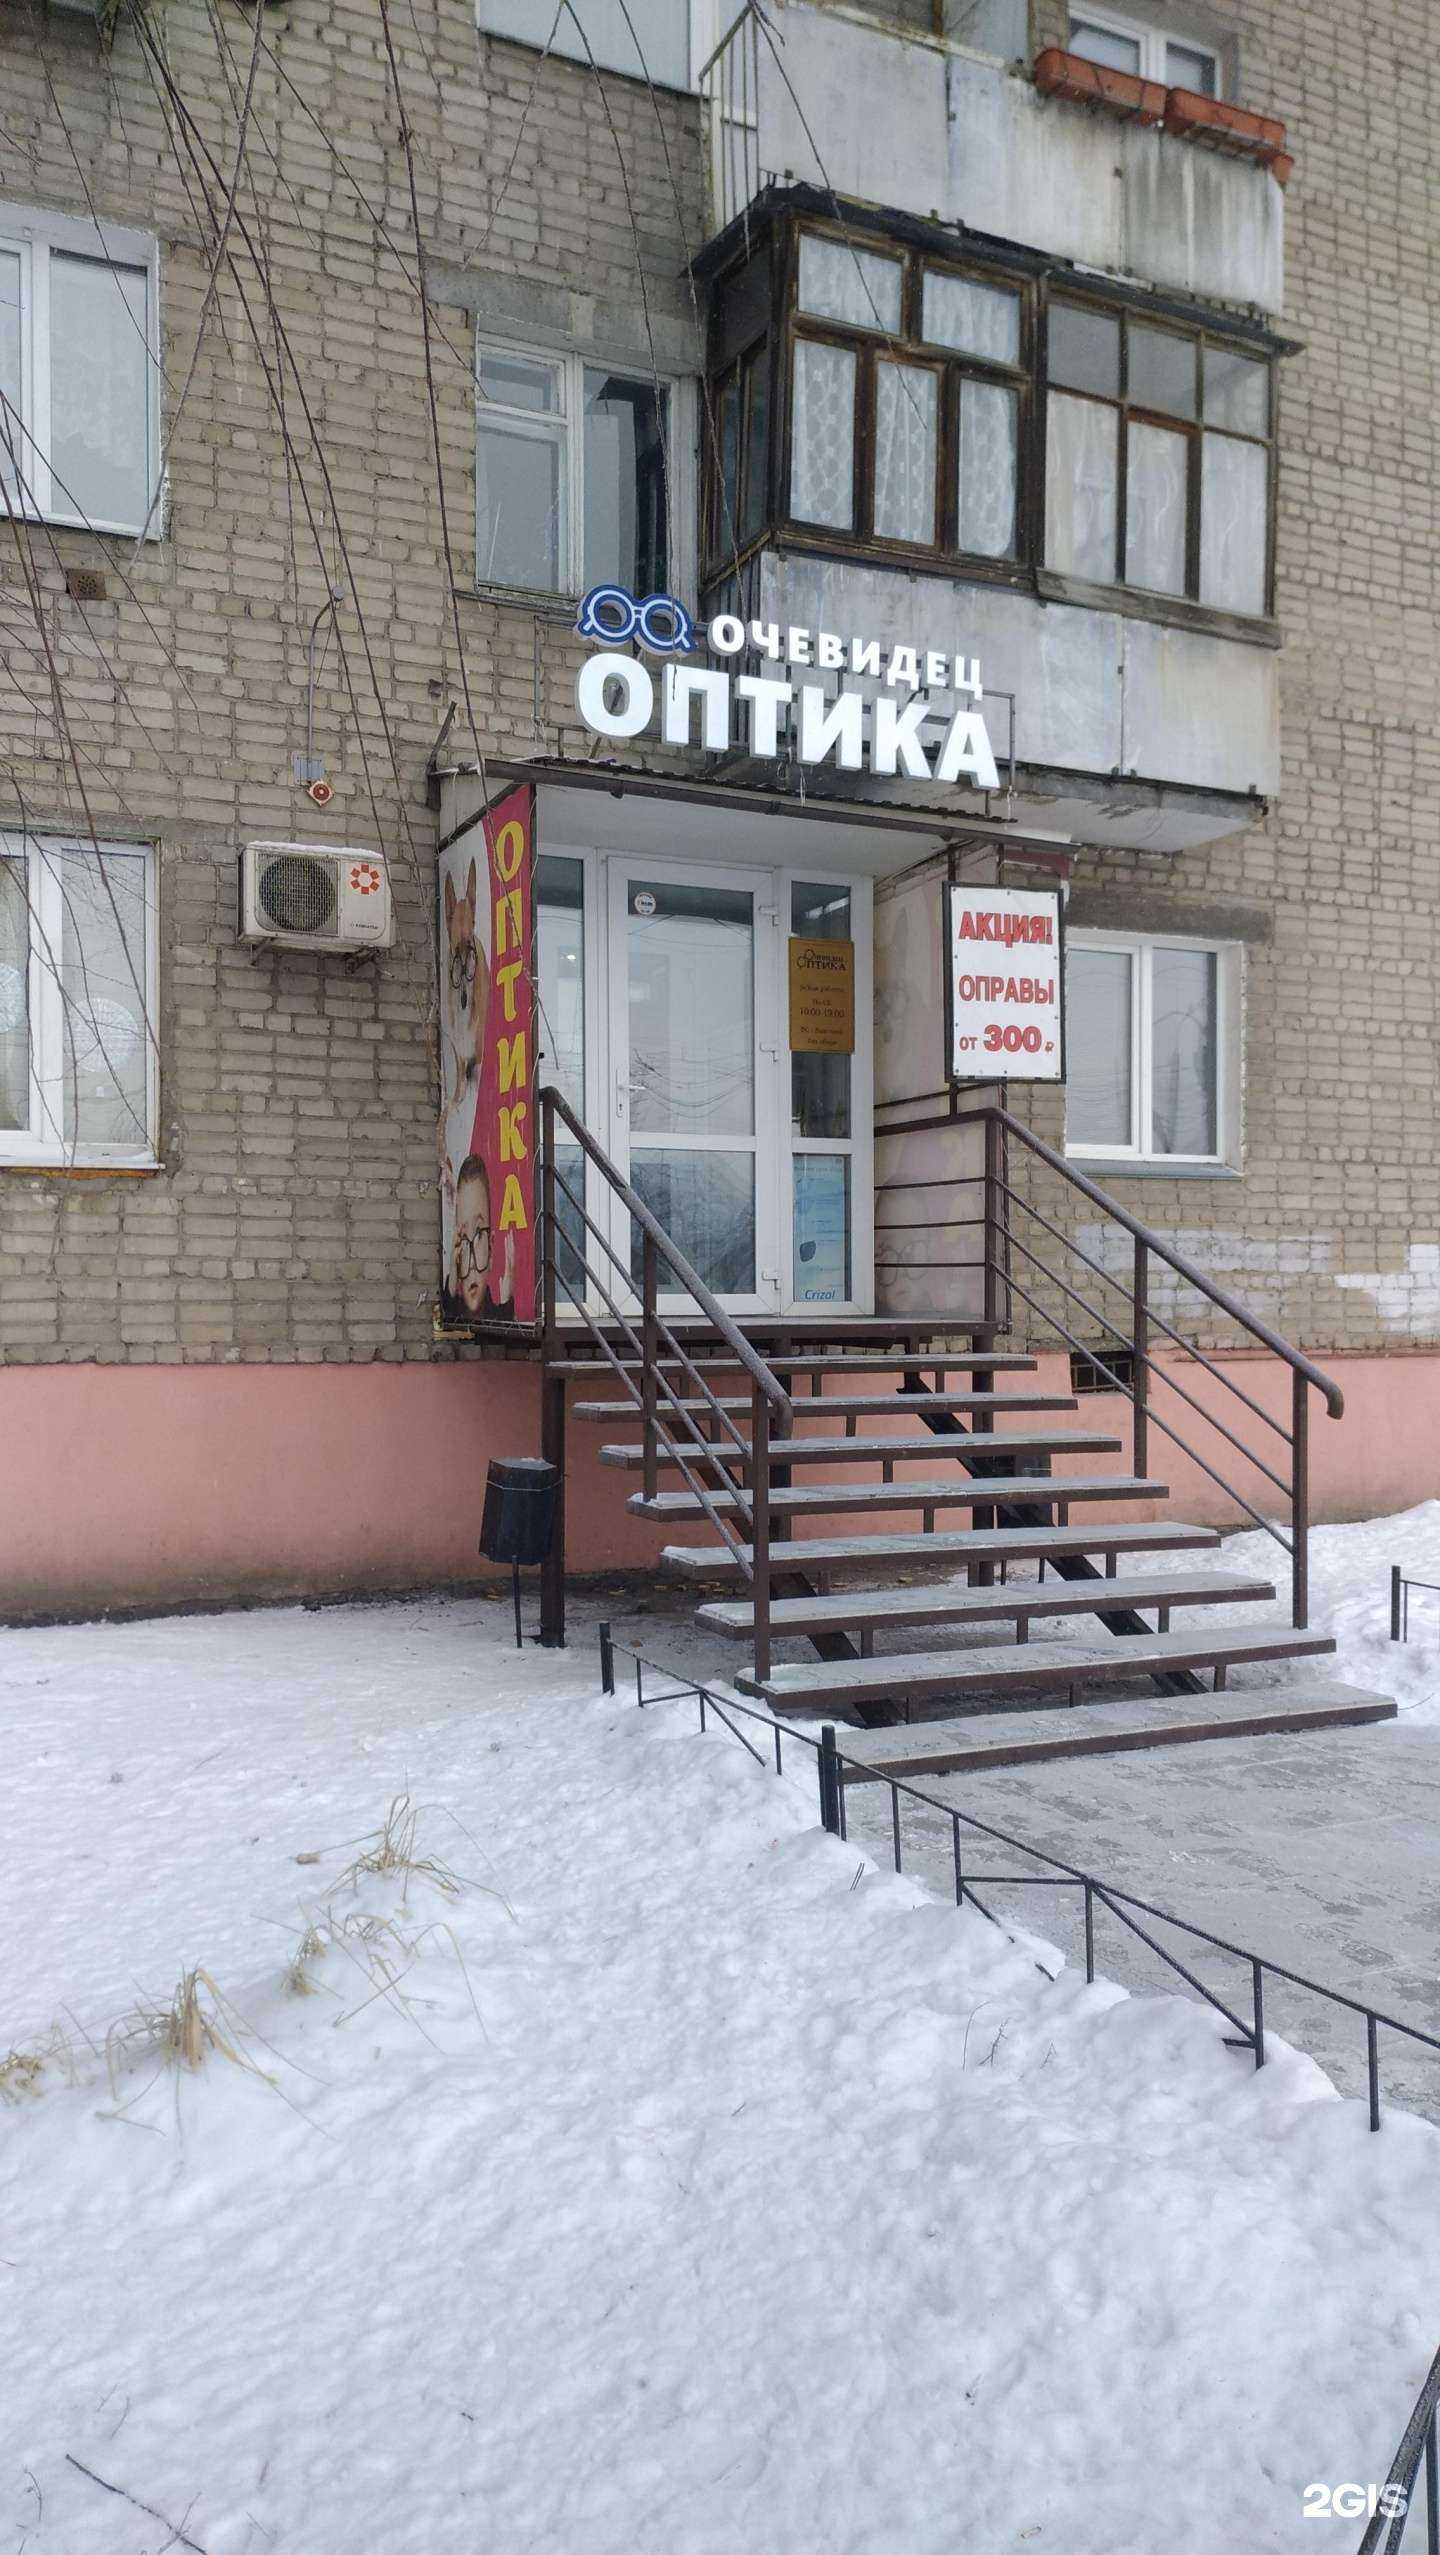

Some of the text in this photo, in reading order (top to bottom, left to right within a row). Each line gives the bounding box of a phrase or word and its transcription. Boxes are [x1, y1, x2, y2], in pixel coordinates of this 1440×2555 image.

[709, 614, 984, 700] ОЧЕВИДЕЦ
[576, 652, 1000, 790] ОПТИКА
[958, 911, 1053, 948] АКЦИЯ!
[495, 819, 528, 1231] ОПТИКА
[959, 975, 1055, 1005] ОПРАВЫ
